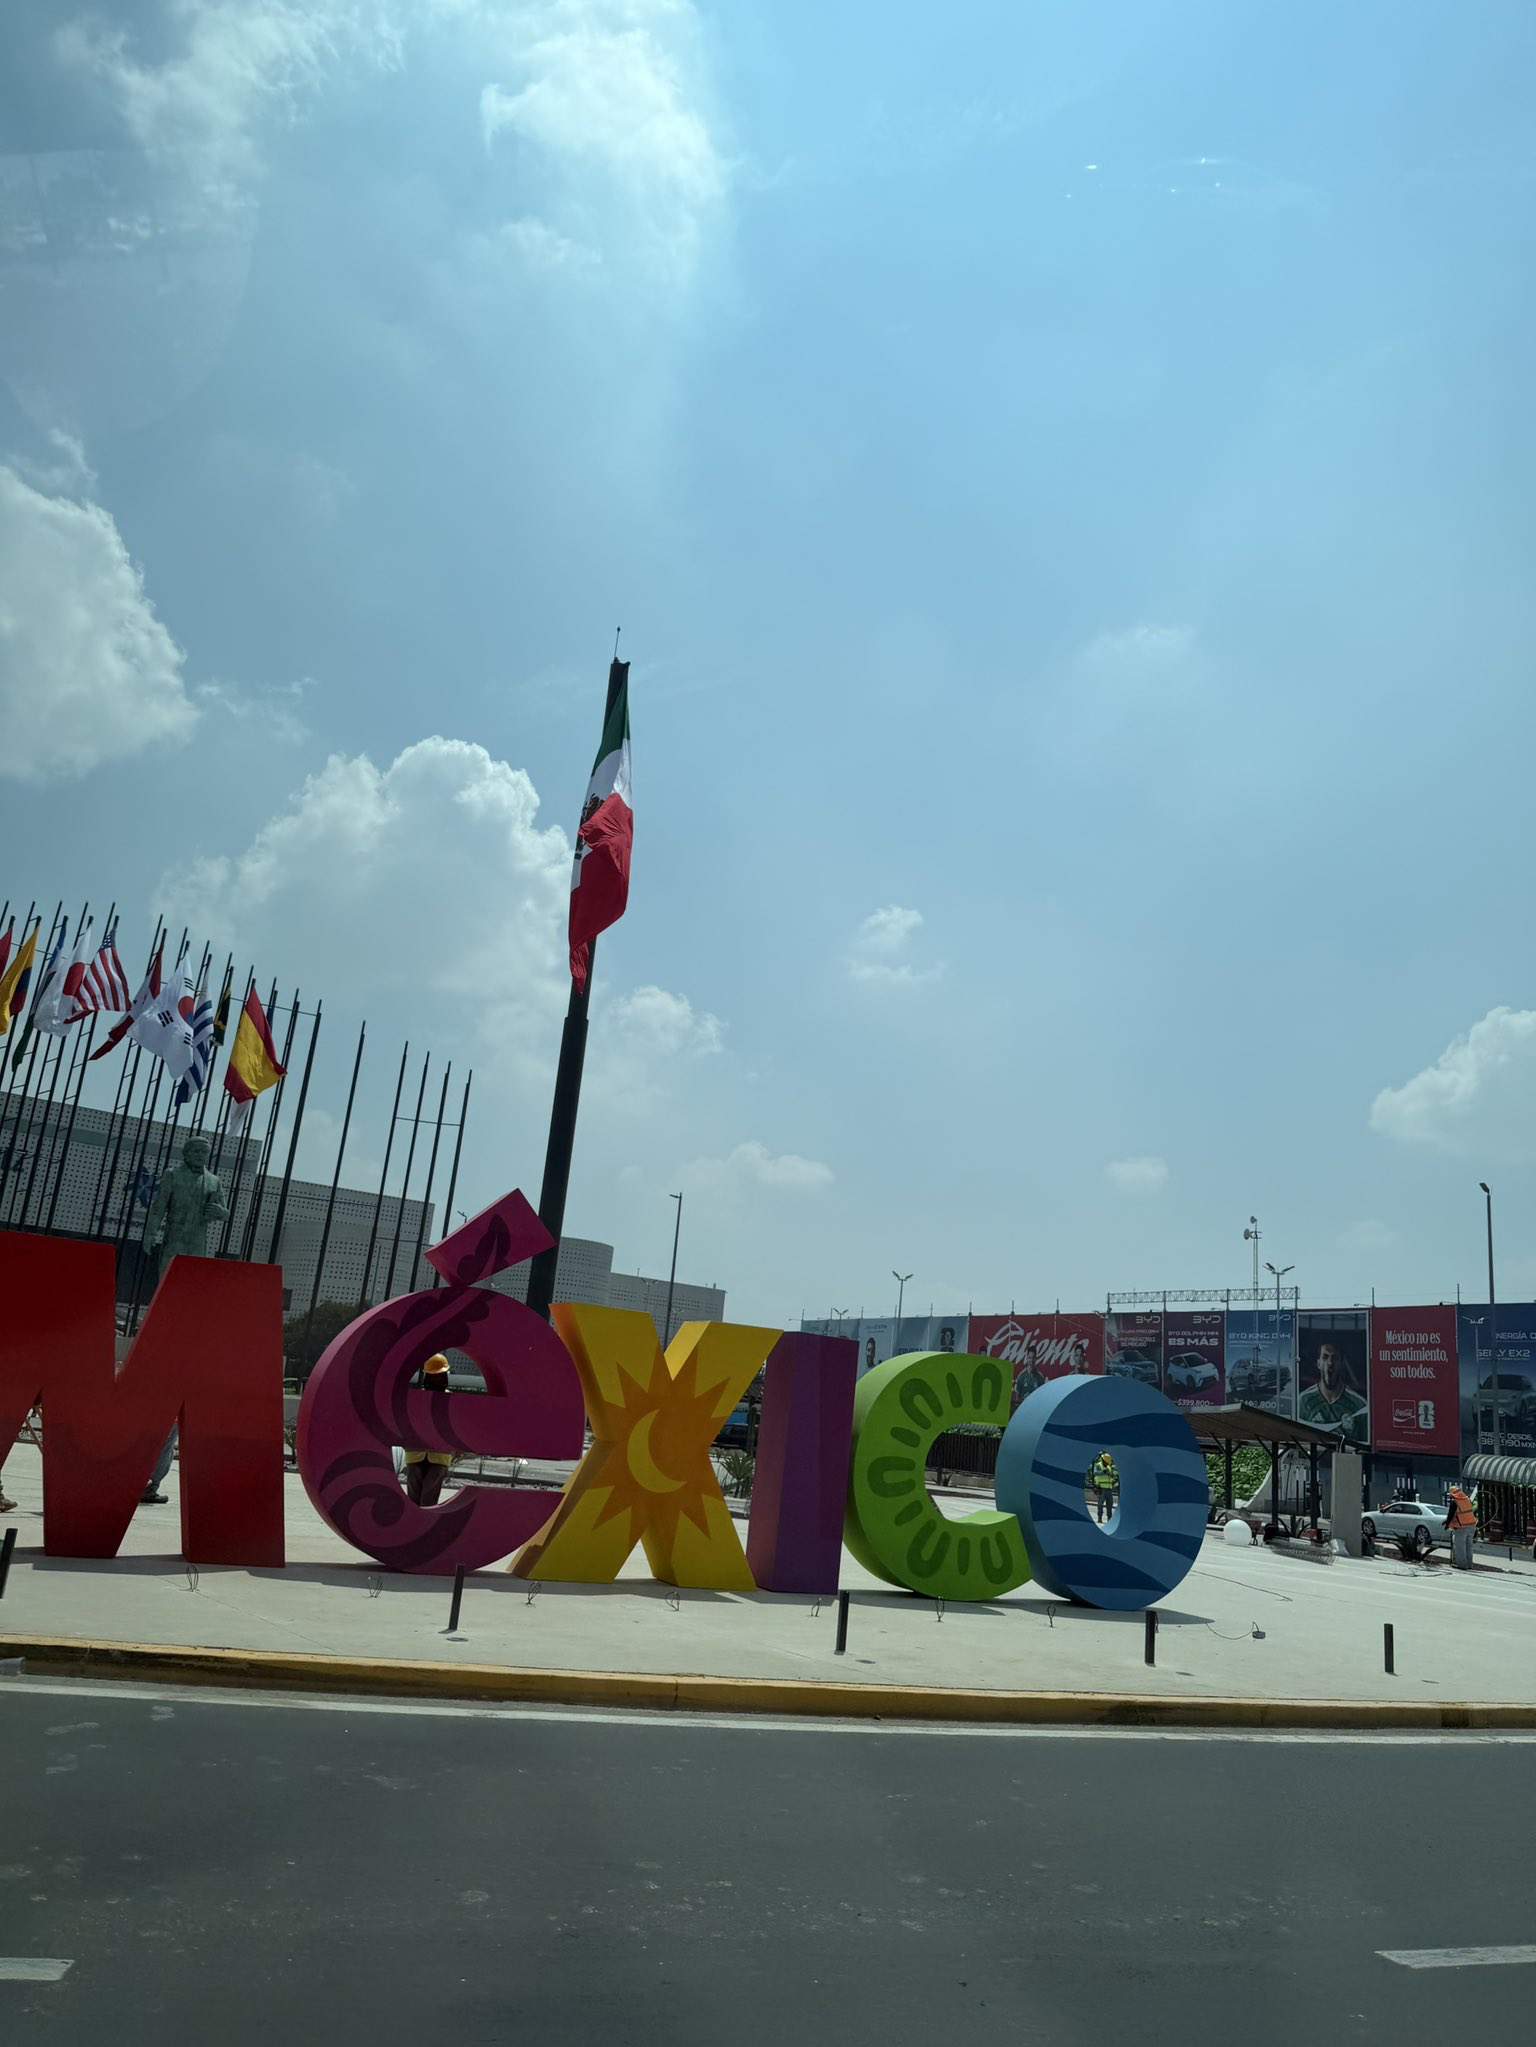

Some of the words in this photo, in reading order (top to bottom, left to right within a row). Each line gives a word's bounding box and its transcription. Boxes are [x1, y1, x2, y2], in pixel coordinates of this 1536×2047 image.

[1136, 1315, 1161, 1324] BYD
[1193, 1315, 1222, 1324] BYD
[1268, 1314, 1291, 1322] BYD
[1168, 1338, 1185, 1346] ES
[1187, 1335, 1219, 1346] MÁS
[1386, 1330, 1415, 1344] México
[1416, 1333, 1428, 1344] no
[1430, 1333, 1441, 1344] es
[1496, 1330, 1528, 1340] NERGÍA
[984, 1319, 1090, 1367] Caliente
[1379, 1350, 1390, 1361] un
[1392, 1347, 1448, 1363] sentimiento,
[1390, 1366, 1406, 1378] son
[1407, 1364, 1436, 1379] todos.
